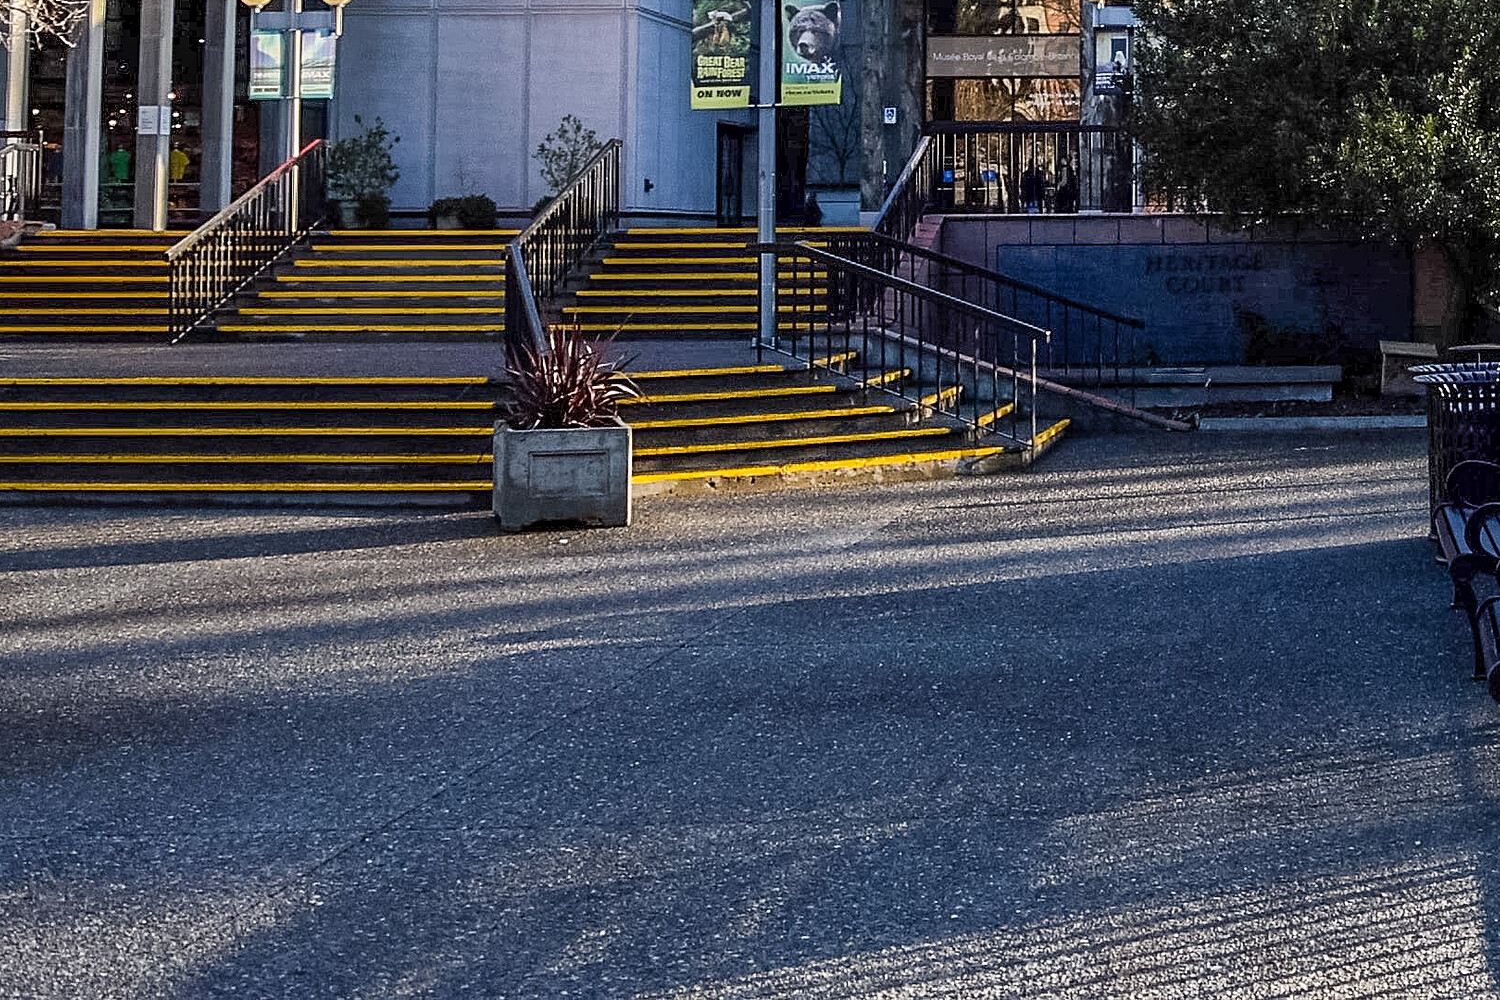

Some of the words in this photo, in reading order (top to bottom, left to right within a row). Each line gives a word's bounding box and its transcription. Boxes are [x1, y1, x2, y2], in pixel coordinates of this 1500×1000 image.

[698, 55, 723, 66] GREAT
[724, 56, 745, 68] BEAR
[786, 62, 836, 74] IMAX
[697, 90, 713, 98] ON
[717, 90, 742, 98] NOW
